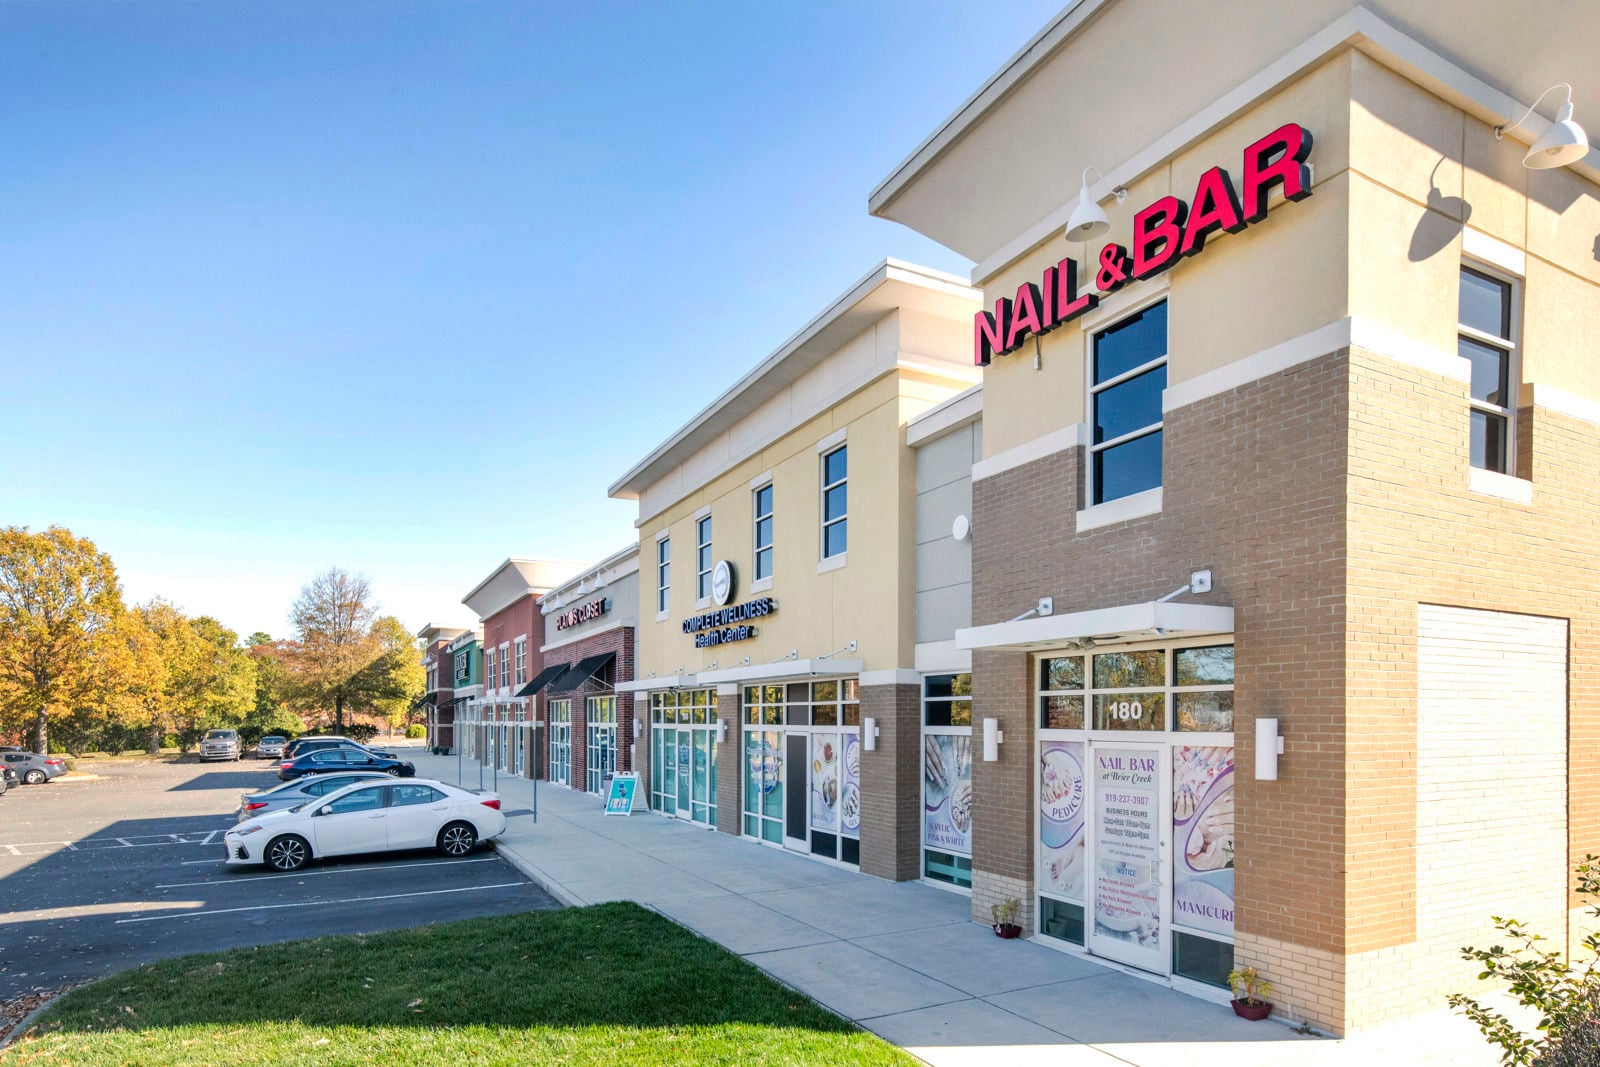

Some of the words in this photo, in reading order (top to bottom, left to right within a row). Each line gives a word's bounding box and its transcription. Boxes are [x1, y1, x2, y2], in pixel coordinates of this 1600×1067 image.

[974, 257, 1099, 367] NAIL
[1096, 243, 1133, 292] &
[1133, 123, 1314, 281] BAR
[578, 597, 606, 623] CLOSET
[682, 611, 720, 634] COMPLETE
[720, 597, 773, 625] WELLNESS
[695, 629, 720, 648] Health
[720, 625, 754, 645] Center
[1109, 701, 1143, 720] 180
[1099, 756, 1126, 770] NAIL
[1129, 758, 1155, 772] BAR
[1102, 772, 1110, 780] at
[1110, 771, 1131, 782] Brier
[1131, 773, 1152, 784] Creek
[1052, 775, 1083, 819] PEDICURE
[1105, 793, 1149, 805] 919-237-3907
[1105, 807, 1130, 816] BUSINESS
[1116, 867, 1137, 877] NOTICE
